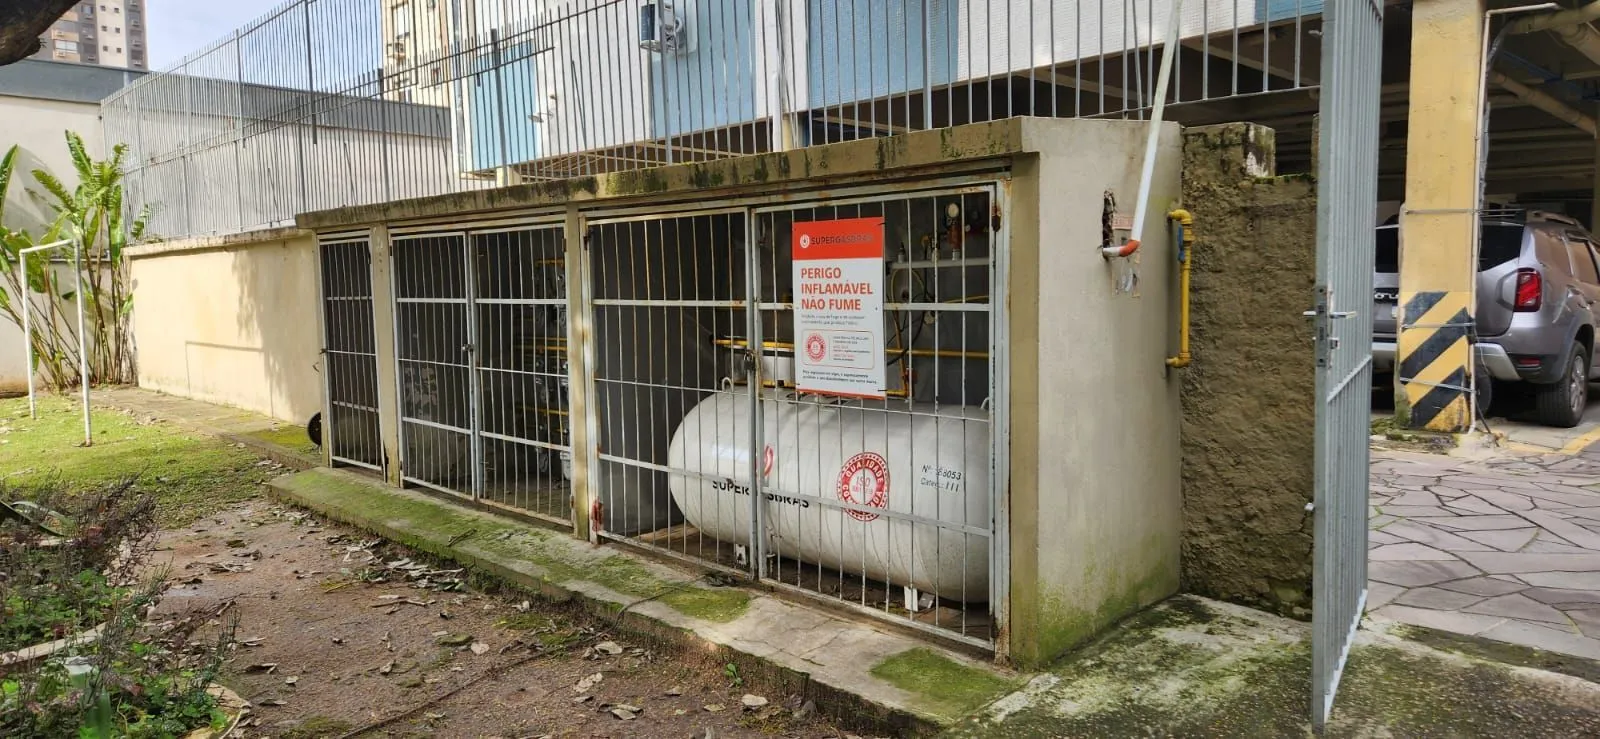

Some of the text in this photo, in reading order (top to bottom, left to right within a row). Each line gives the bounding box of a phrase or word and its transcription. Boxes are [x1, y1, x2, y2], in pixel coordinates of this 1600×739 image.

[801, 267, 841, 279] PERIGO
[801, 280, 873, 296] INFLAMÁVEL
[801, 296, 861, 311] NÃO FUME
